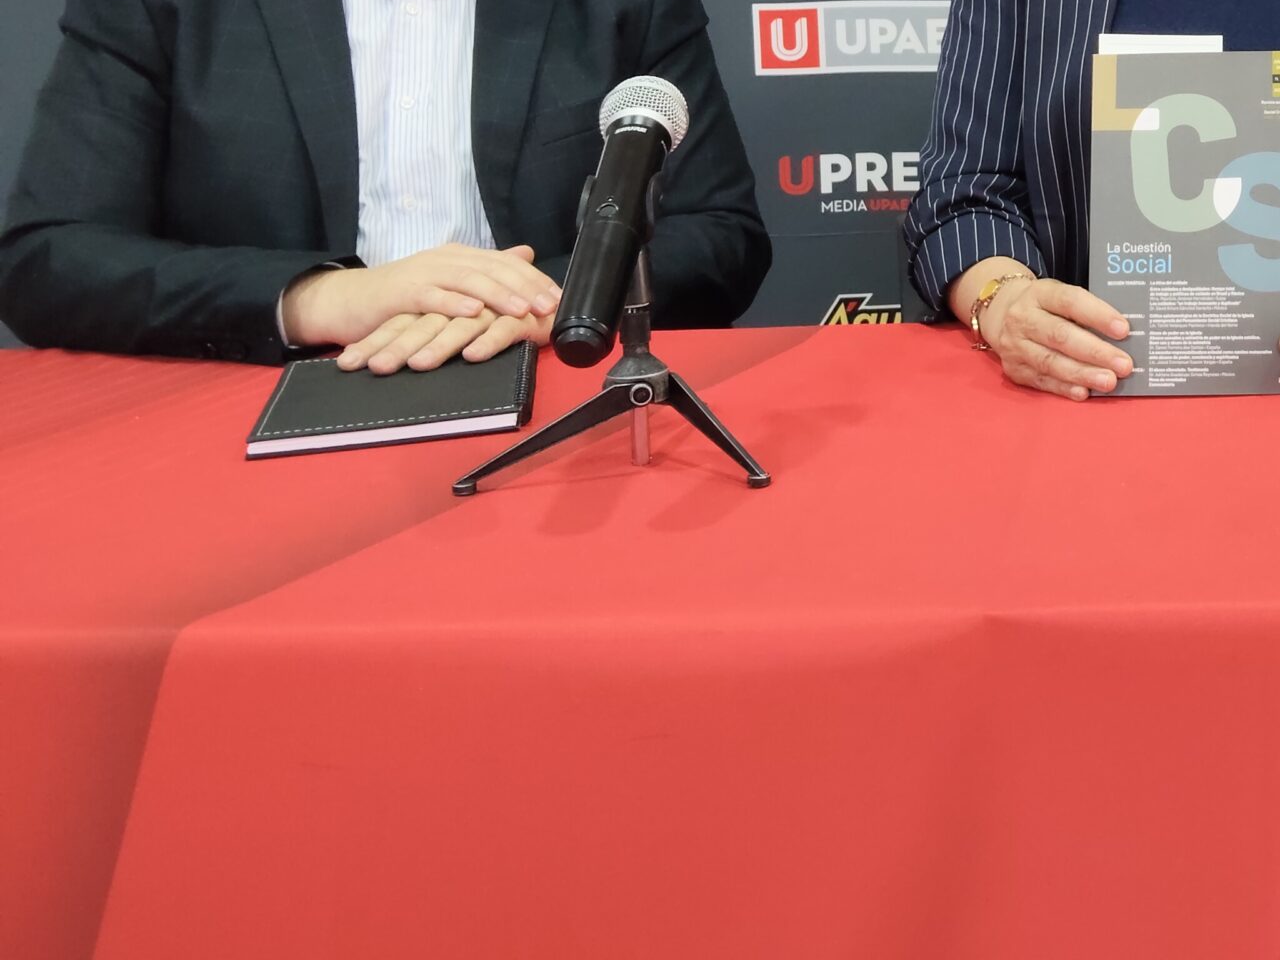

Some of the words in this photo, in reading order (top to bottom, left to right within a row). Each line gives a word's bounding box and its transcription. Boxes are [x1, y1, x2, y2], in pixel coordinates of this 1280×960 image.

[835, 18, 947, 55] UPAE
[778, 151, 920, 196] UPRE
[821, 200, 867, 214] MEDIA
[869, 198, 909, 212] UPAE
[1107, 242, 1121, 253] La
[1122, 242, 1172, 253] Cuestión
[1107, 254, 1172, 274] Social
